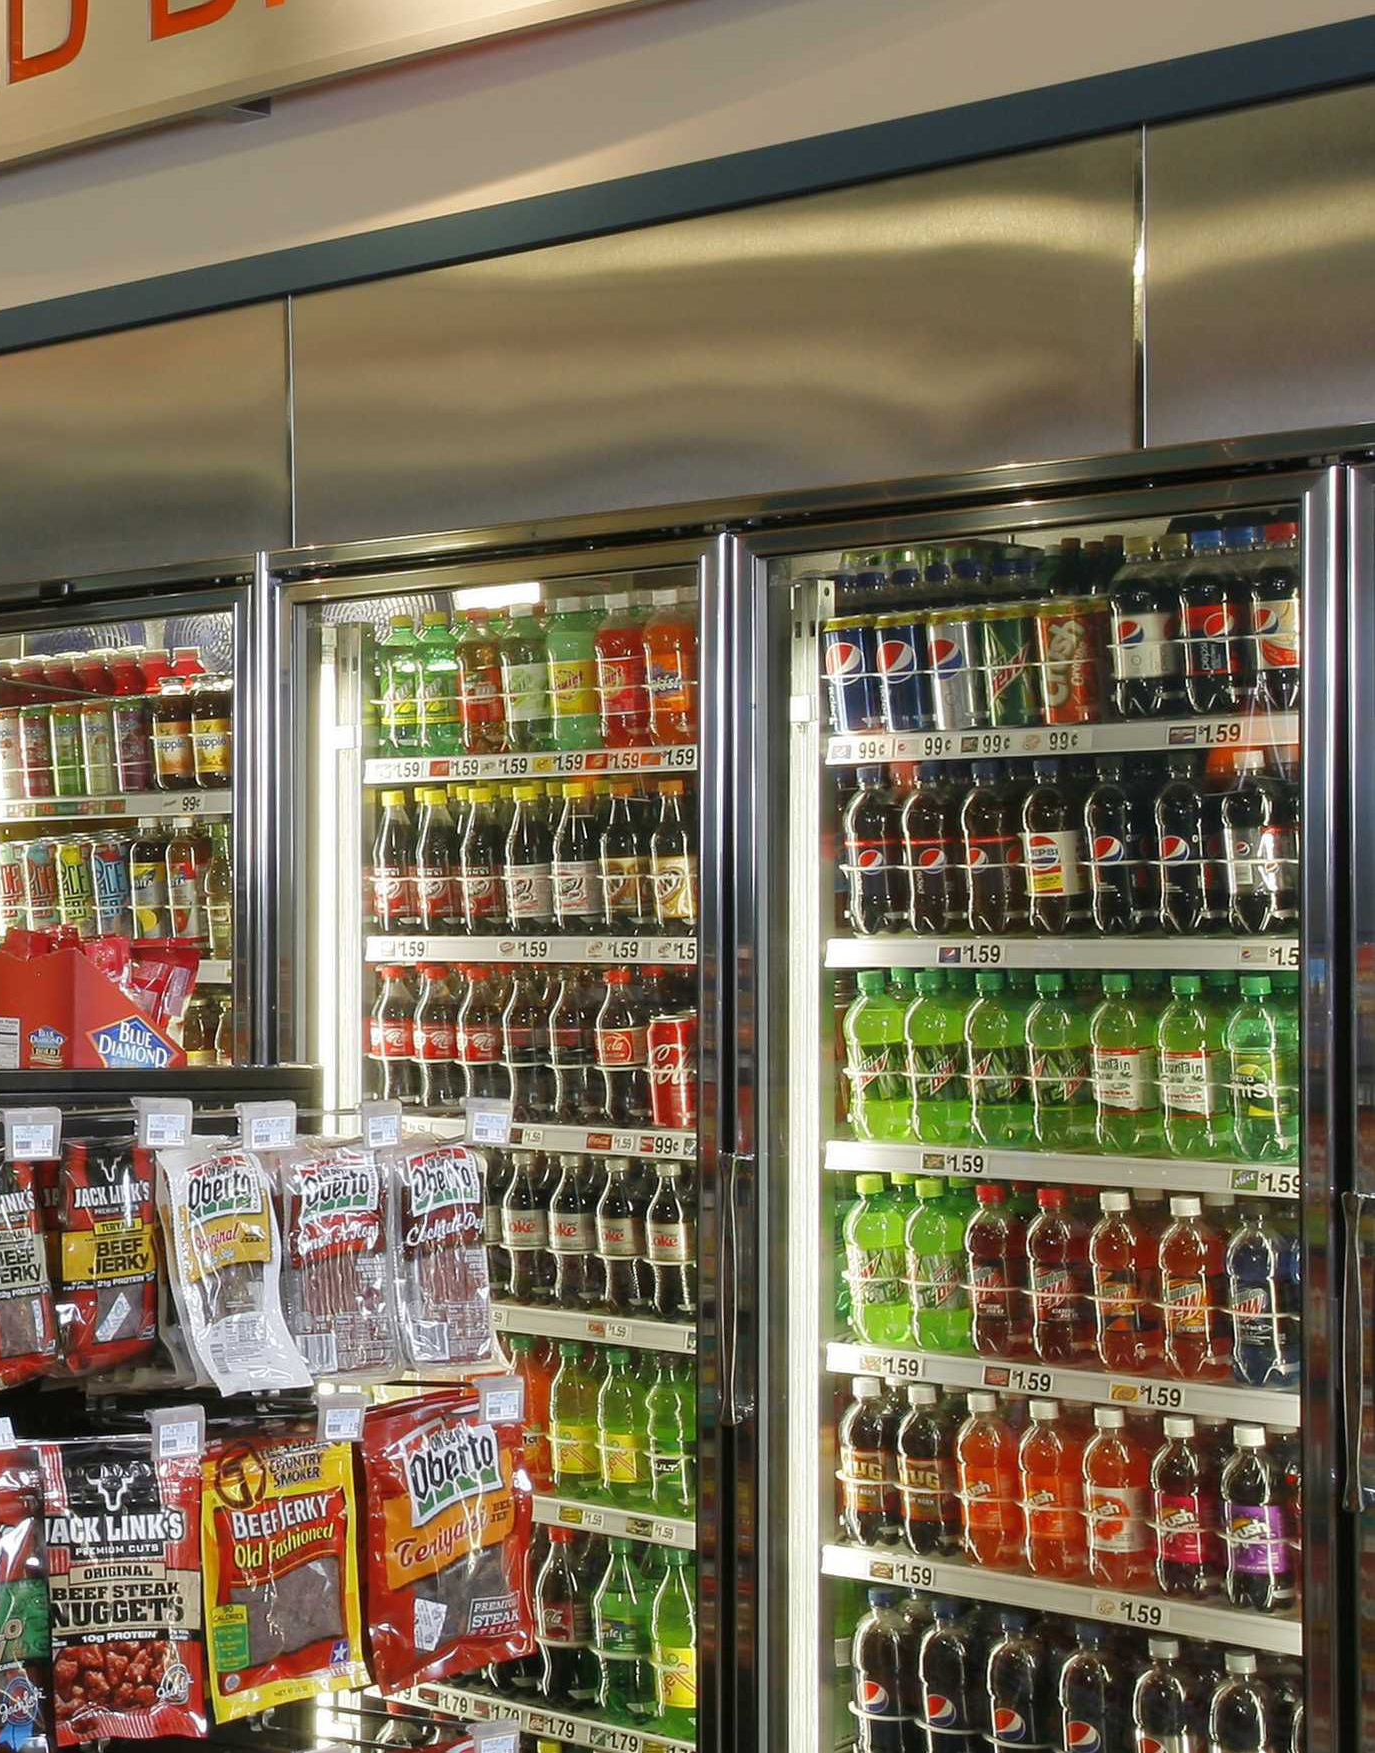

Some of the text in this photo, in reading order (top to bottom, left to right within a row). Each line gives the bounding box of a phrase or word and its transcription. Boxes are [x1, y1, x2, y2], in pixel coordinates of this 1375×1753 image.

[1049, 731, 1078, 750] 99¢
[1198, 724, 1241, 743] $1.59
[982, 735, 1010, 753] 99¢
[963, 945, 1000, 964] $1.59
[1269, 947, 1299, 966] $1.5
[119, 1022, 153, 1047] BLUE
[99, 1034, 168, 1068] DIAMOND
[655, 1137, 678, 1153] 99¢
[947, 1154, 984, 1174] $1.59
[74, 1187, 109, 1208] JACK
[188, 1166, 250, 1210] Oberto
[97, 1239, 143, 1257] BEEF
[88, 1254, 149, 1275] JERKY
[113, 1275, 144, 1286] PROTEIN
[883, 1358, 919, 1376] $1.59
[1013, 1371, 1051, 1391] $1.59
[1140, 1385, 1182, 1407] $1.59
[410, 1435, 494, 1499] Oberto
[273, 1468, 321, 1488] SMOKER
[107, 1509, 184, 1541] LINK'S
[231, 1495, 329, 1540] BEEF JERKY
[75, 1542, 159, 1556] PREMIUM CUTS
[234, 1523, 334, 1568] Old Fashioned
[83, 1565, 152, 1579] ORIGINAL
[896, 1565, 932, 1585] $1.59
[52, 1581, 179, 1599] BEEF STEAK
[52, 1600, 185, 1628] NUGGETS
[1120, 1601, 1162, 1625] $1.59
[82, 1631, 156, 1644] 10g PROTEIN
